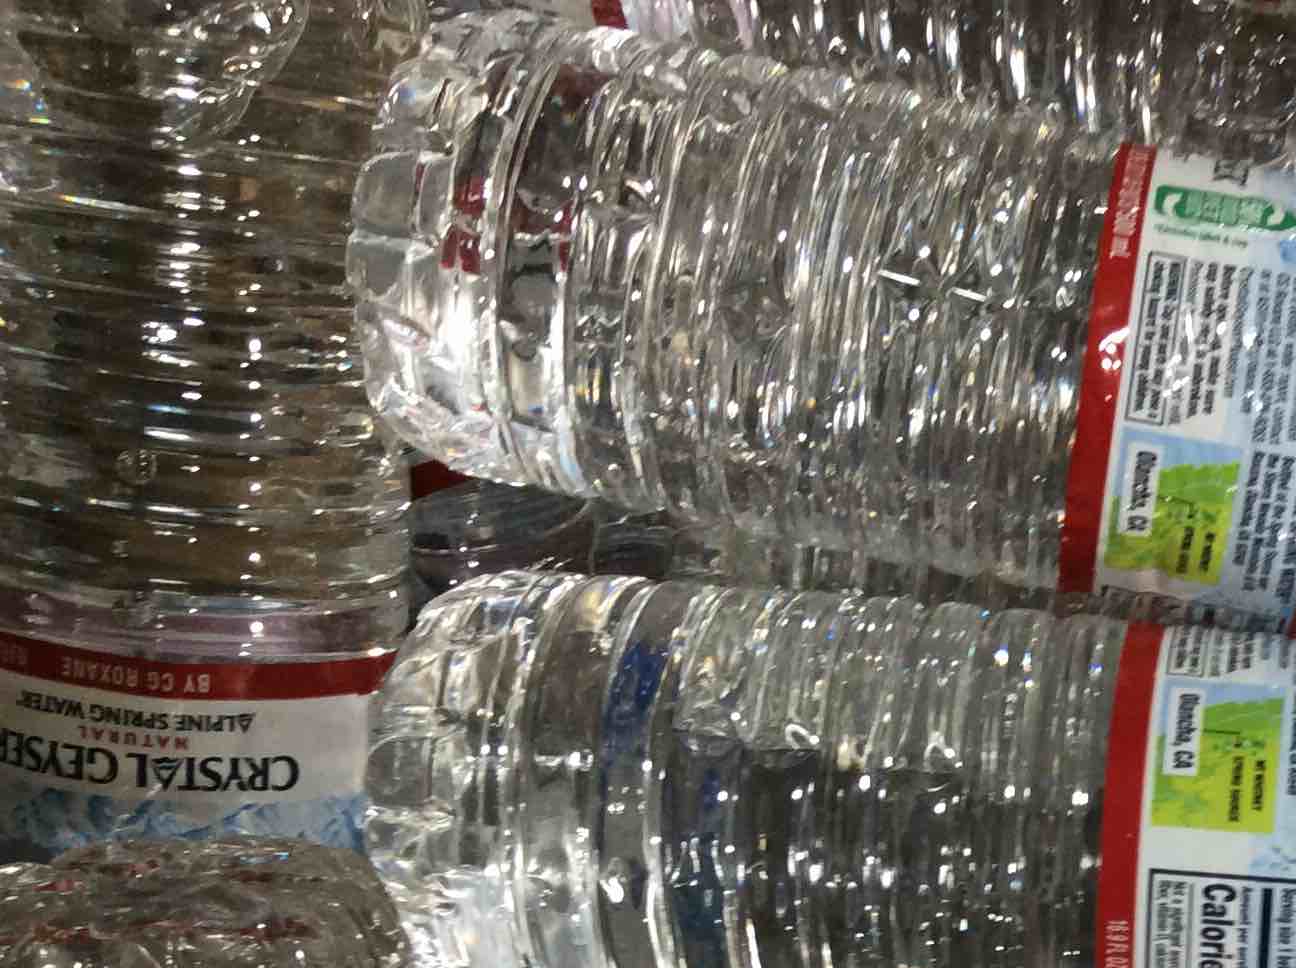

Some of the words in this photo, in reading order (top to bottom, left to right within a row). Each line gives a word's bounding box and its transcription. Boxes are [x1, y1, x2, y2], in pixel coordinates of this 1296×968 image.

[145, 665, 175, 688] CG
[184, 669, 211, 692] BY
[88, 702, 166, 728] SPRING
[176, 708, 254, 733] ALPINE
[1173, 693, 1201, 747] Olancha,
[76, 725, 189, 750] NATURAL
[125, 753, 299, 792] CRYSTAL
[1171, 750, 1195, 770] CA
